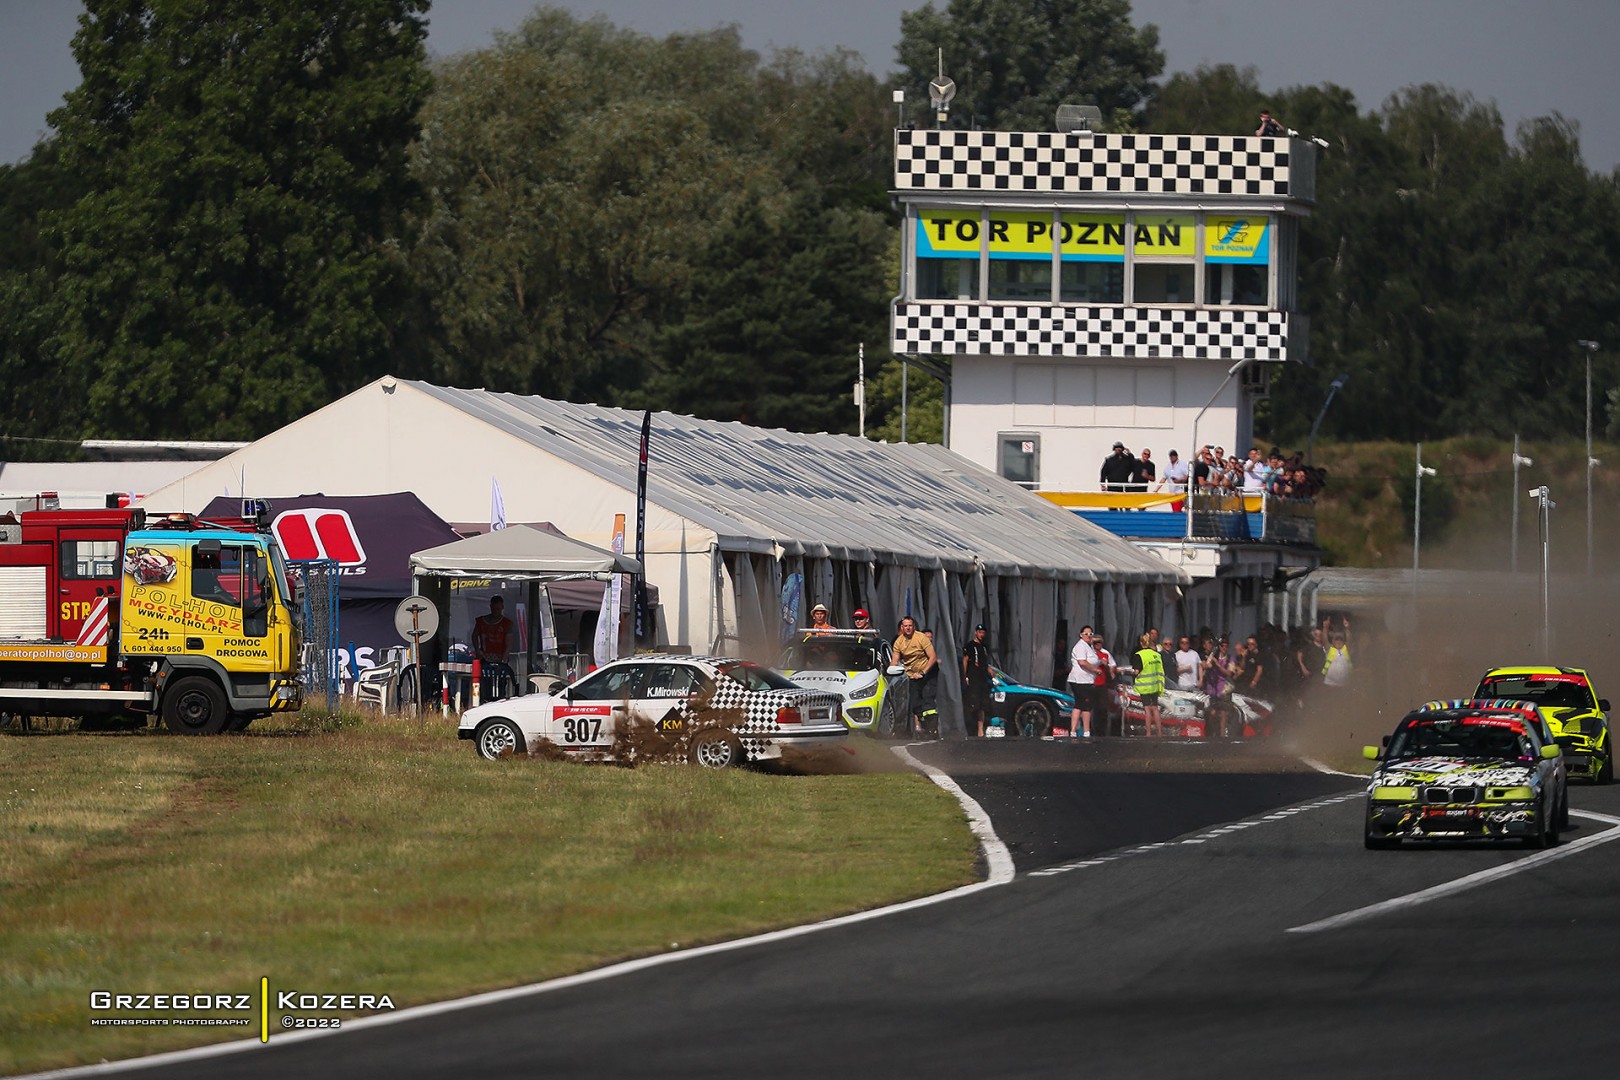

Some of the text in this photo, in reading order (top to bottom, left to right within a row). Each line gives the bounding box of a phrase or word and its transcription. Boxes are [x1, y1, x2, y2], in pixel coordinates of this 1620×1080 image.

[931, 218, 1181, 248] TOR POZNAŃ
[459, 580, 491, 588] DRIVE
[130, 585, 242, 623] POL-HOL
[129, 599, 241, 630] MOCYDLARZ
[138, 608, 224, 634] WWW.POLHOL.PL
[138, 628, 169, 640] 24h
[223, 639, 261, 647] POMOC
[216, 649, 268, 657] DROGOWA
[646, 686, 689, 698] K.Mirowski
[563, 718, 602, 743] 307
[662, 719, 683, 730] KM
